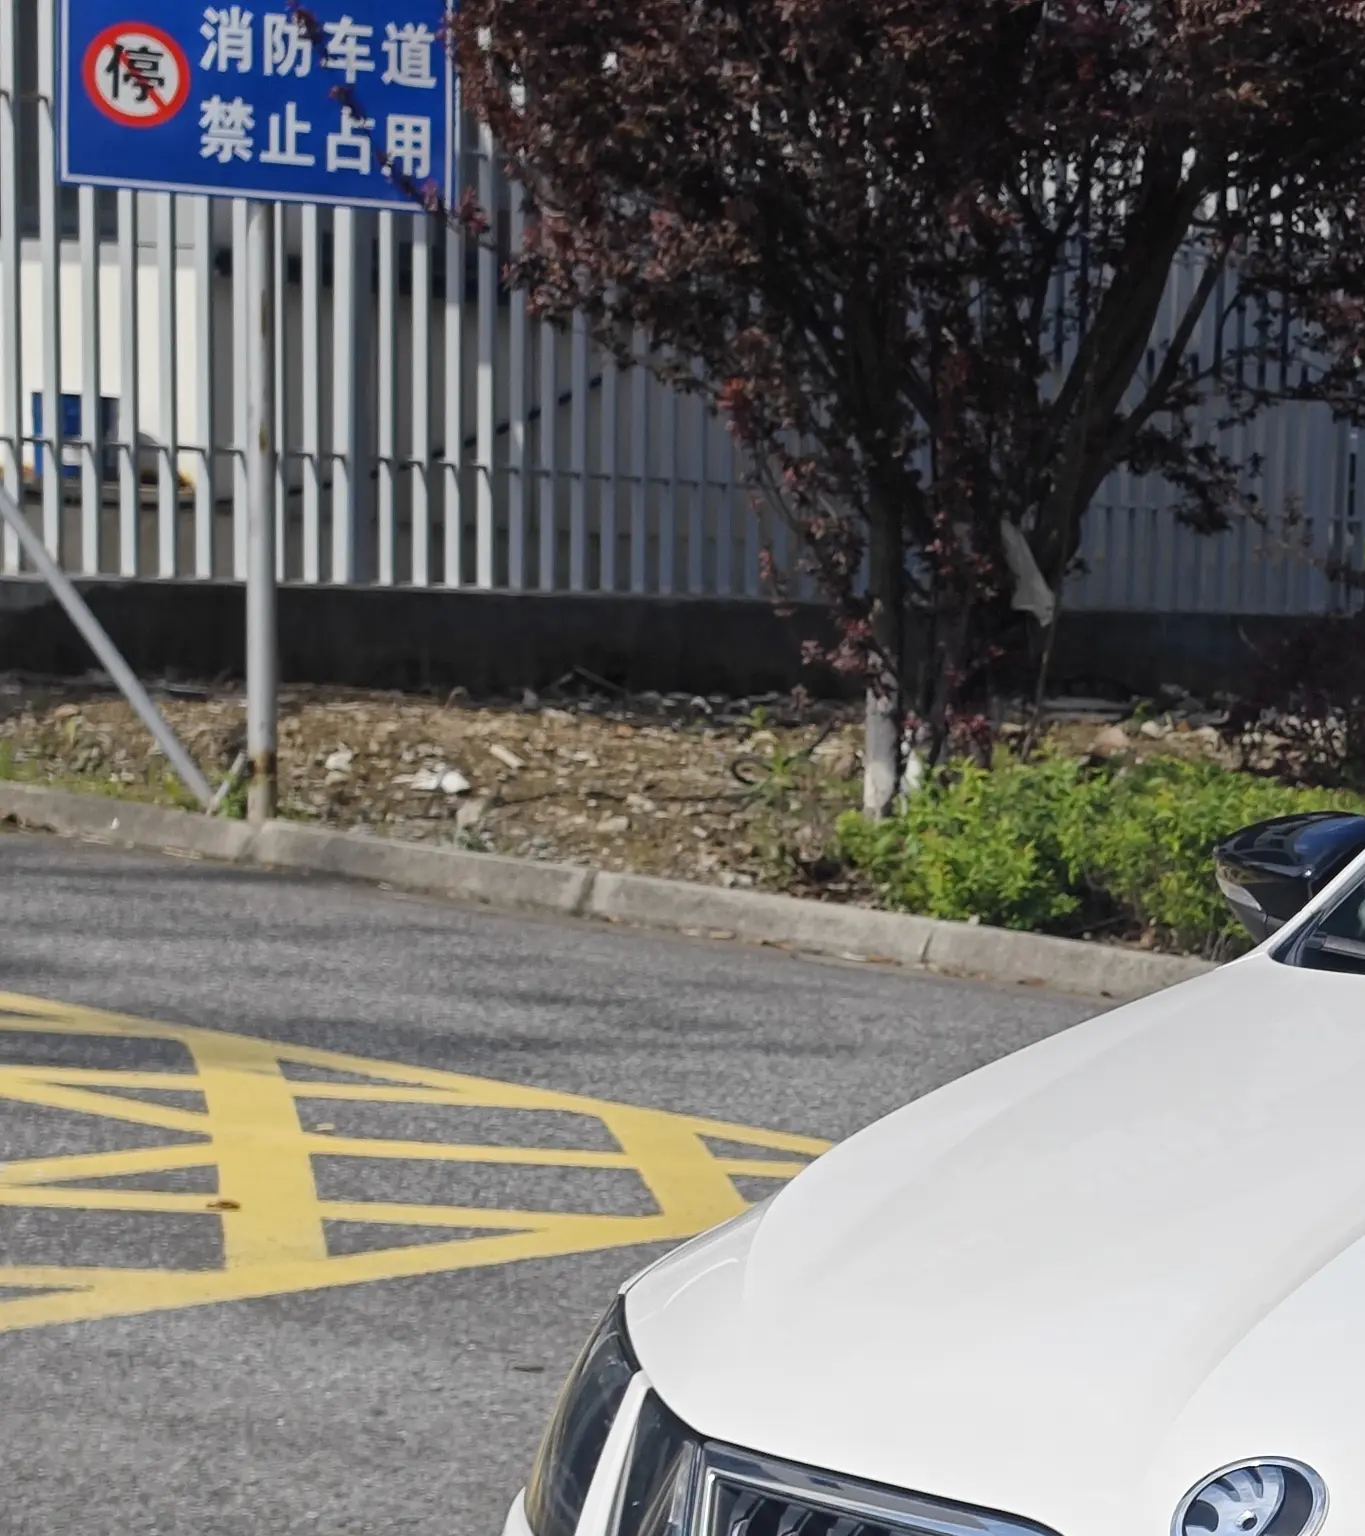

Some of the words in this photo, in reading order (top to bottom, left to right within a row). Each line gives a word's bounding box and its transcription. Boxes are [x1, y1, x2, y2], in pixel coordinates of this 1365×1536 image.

[105, 44, 167, 101] 停
[199, 6, 437, 90] 消防车道
[199, 95, 432, 179] 禁止占用
